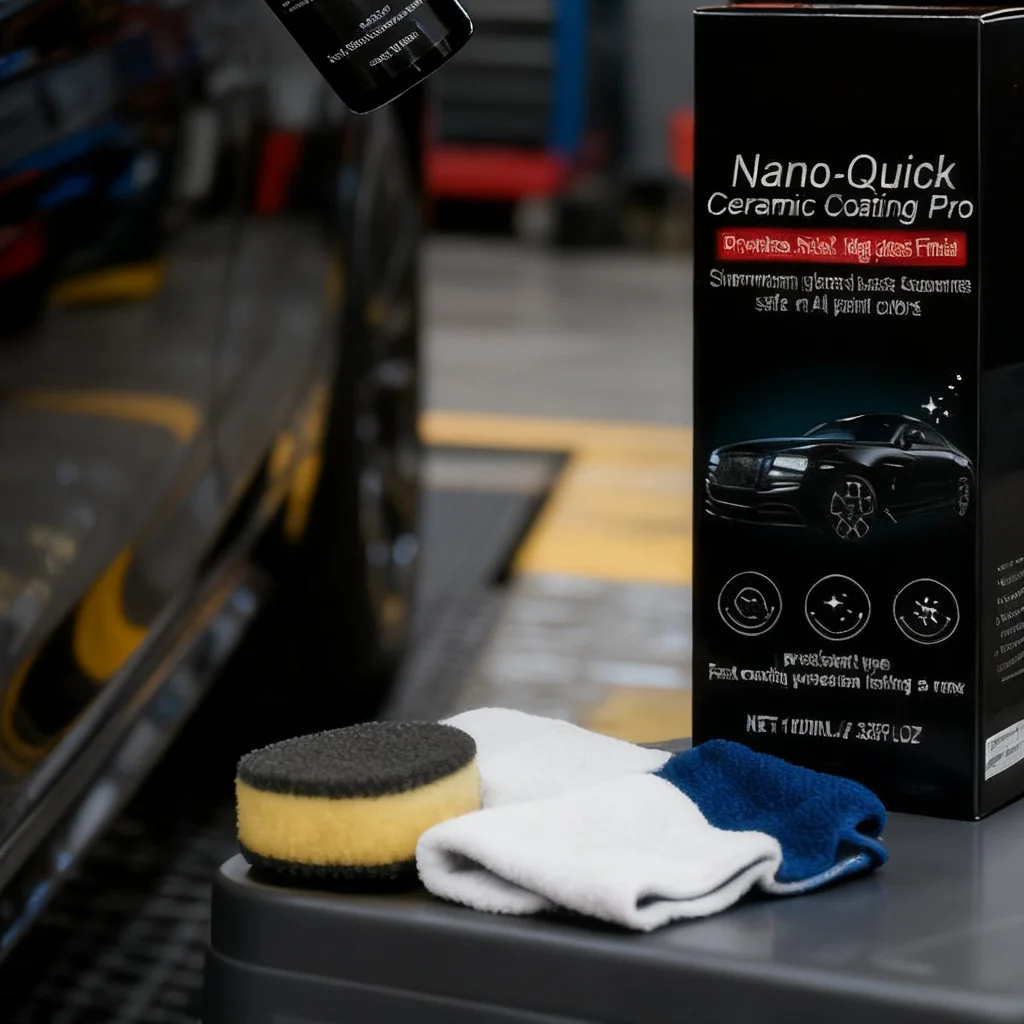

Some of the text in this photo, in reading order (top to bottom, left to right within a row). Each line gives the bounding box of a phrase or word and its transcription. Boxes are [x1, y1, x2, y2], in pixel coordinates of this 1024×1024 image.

[732, 153, 957, 191] Nano-Quick
[707, 191, 974, 225] Ceramic Coating Pro
